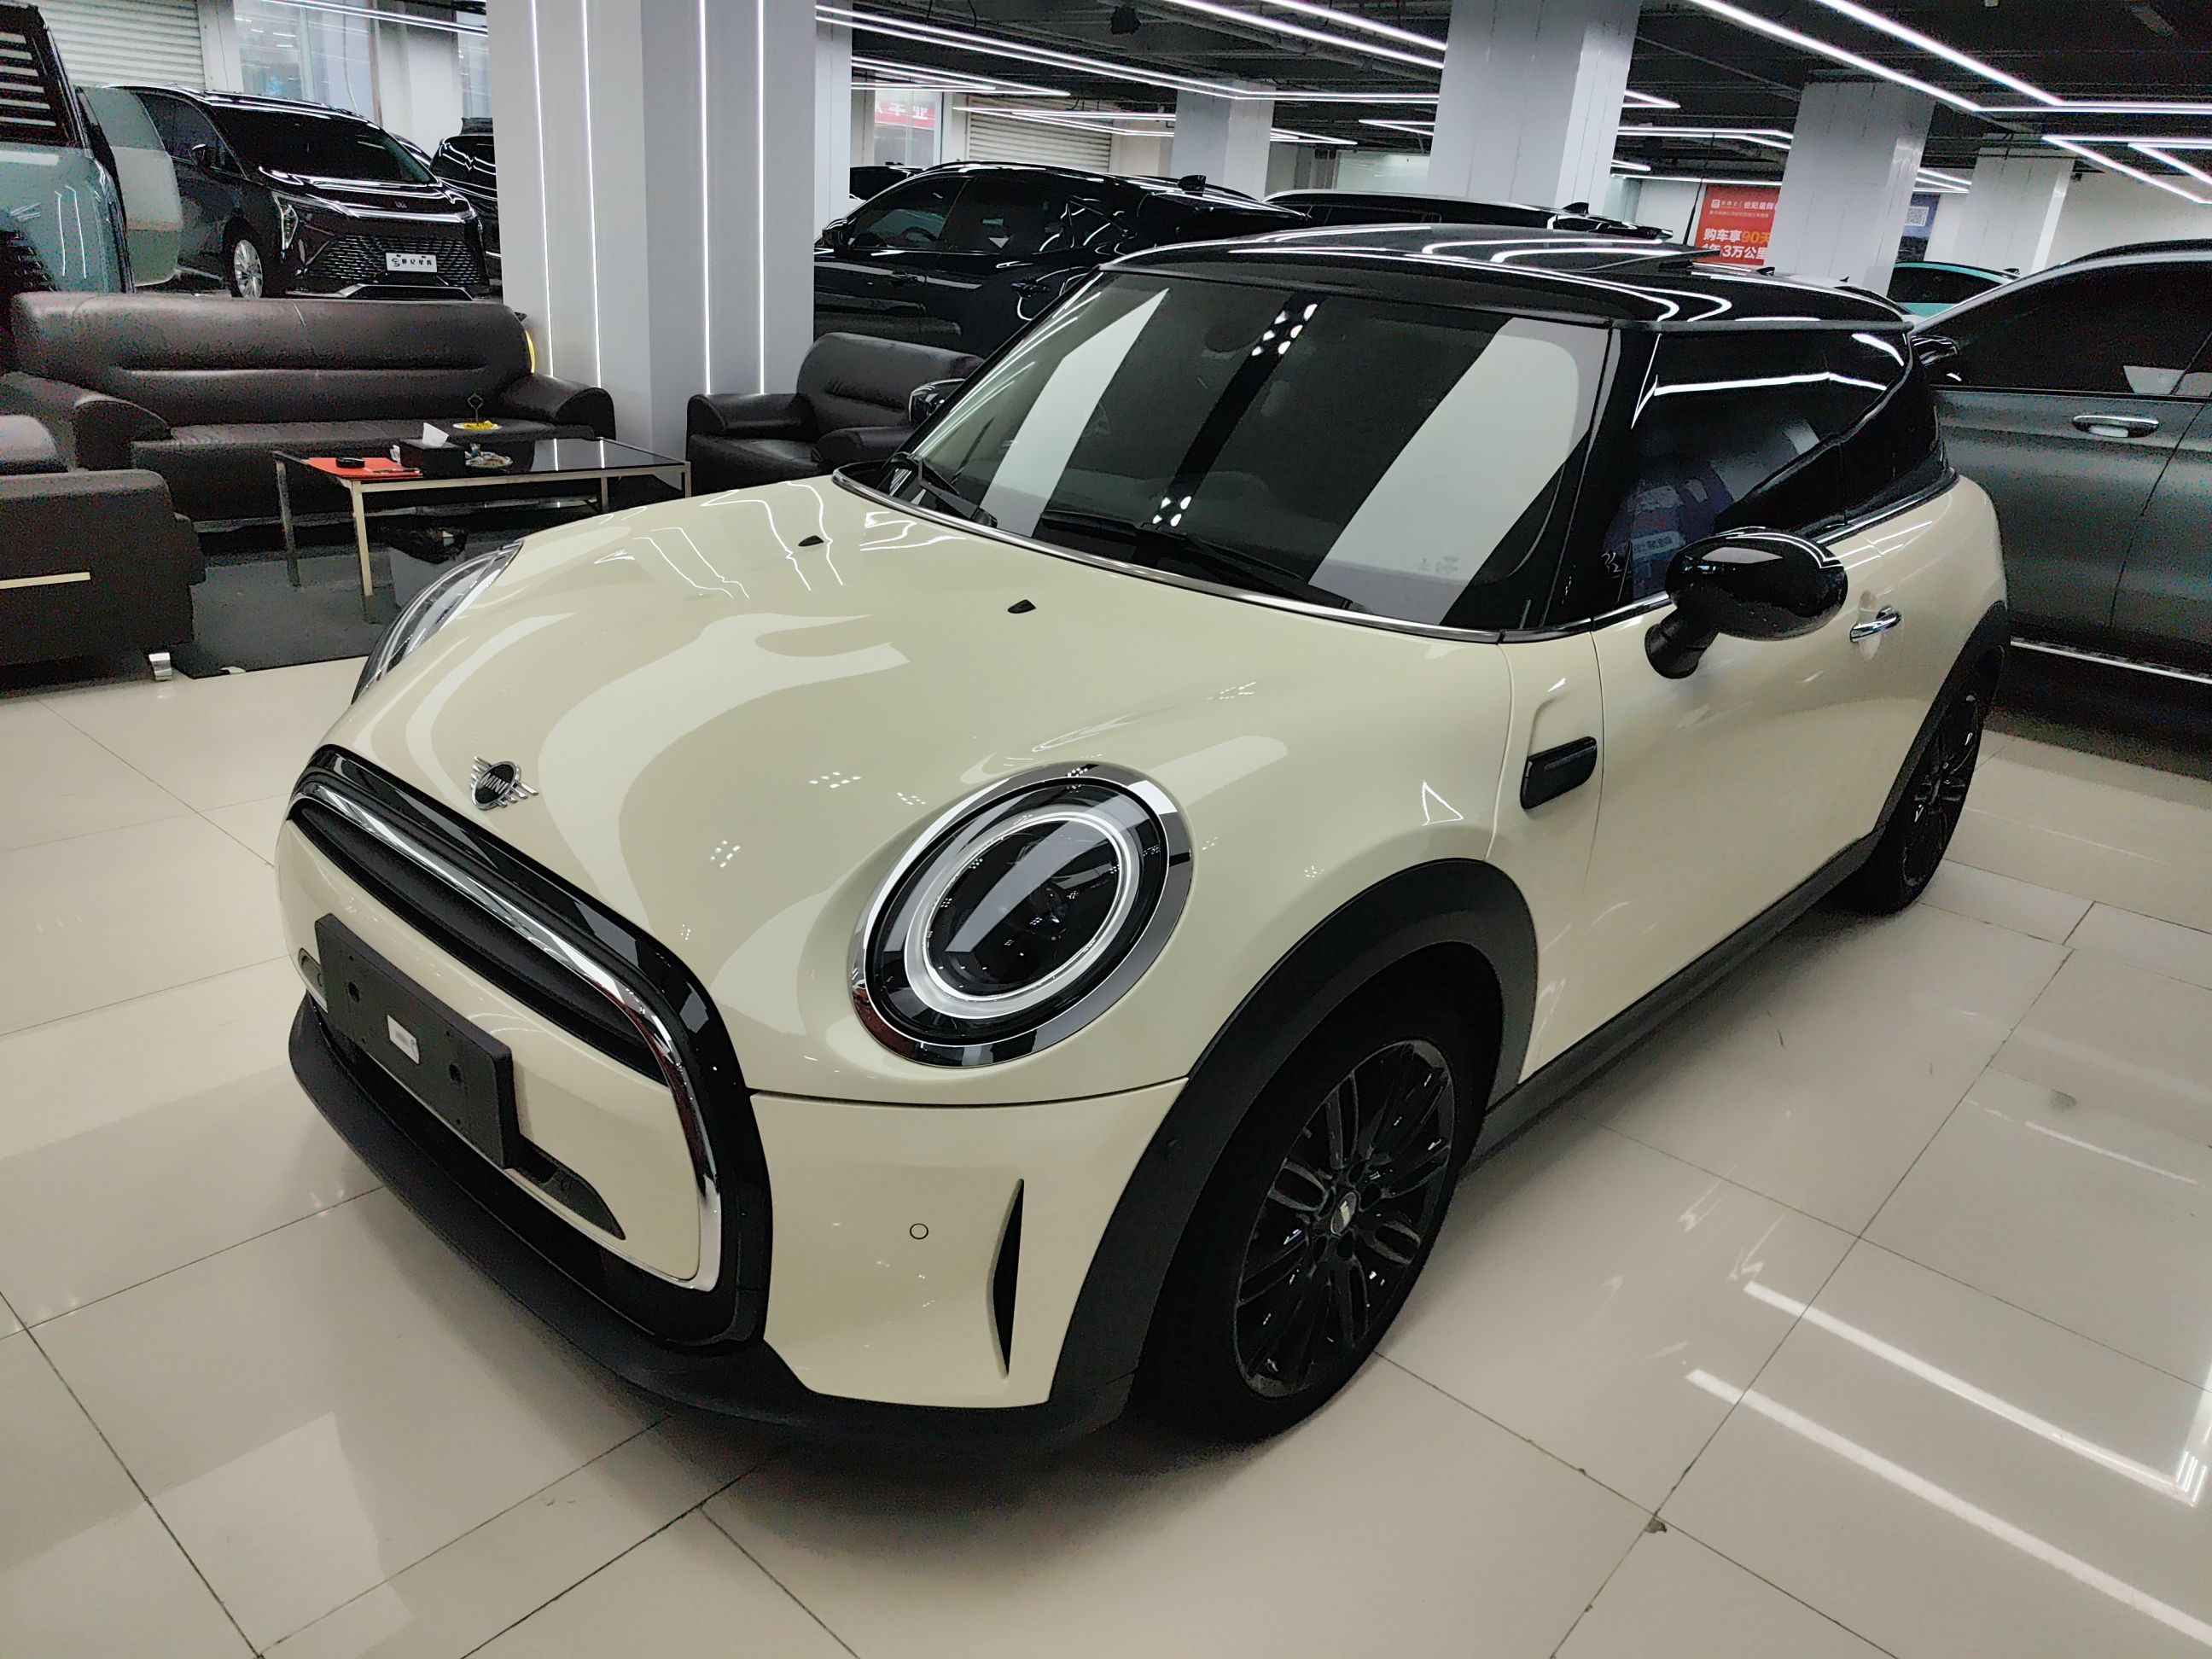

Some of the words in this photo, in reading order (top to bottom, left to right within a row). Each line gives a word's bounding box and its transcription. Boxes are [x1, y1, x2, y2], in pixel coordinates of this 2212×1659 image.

[1743, 201, 1776, 210] 世纪星辉
[480, 772, 509, 795] MINI
